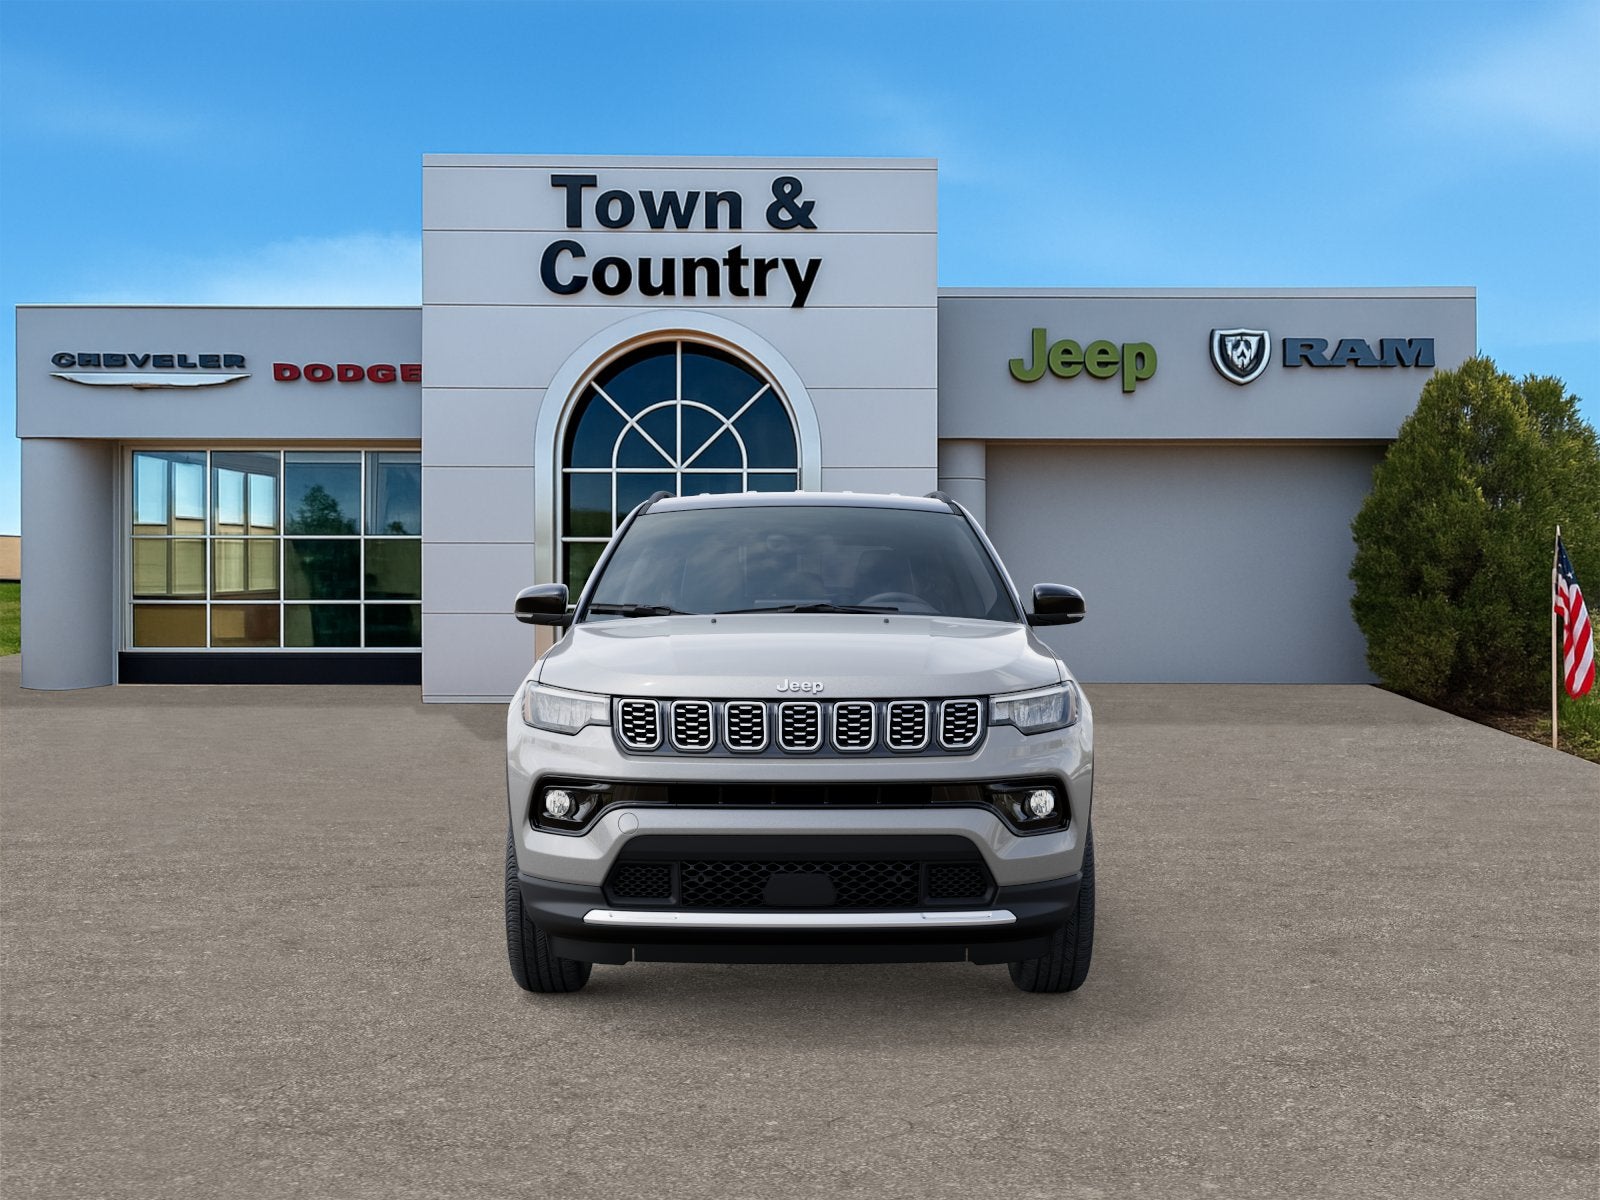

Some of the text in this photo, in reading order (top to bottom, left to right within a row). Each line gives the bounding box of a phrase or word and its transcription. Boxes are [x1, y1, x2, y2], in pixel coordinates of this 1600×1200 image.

[551, 174, 818, 230] Town &
[540, 239, 823, 309] Country
[272, 362, 422, 383] DODGE
[1008, 328, 1157, 393] Jeep
[1283, 338, 1435, 368] RAM
[776, 679, 823, 694] Jeep
